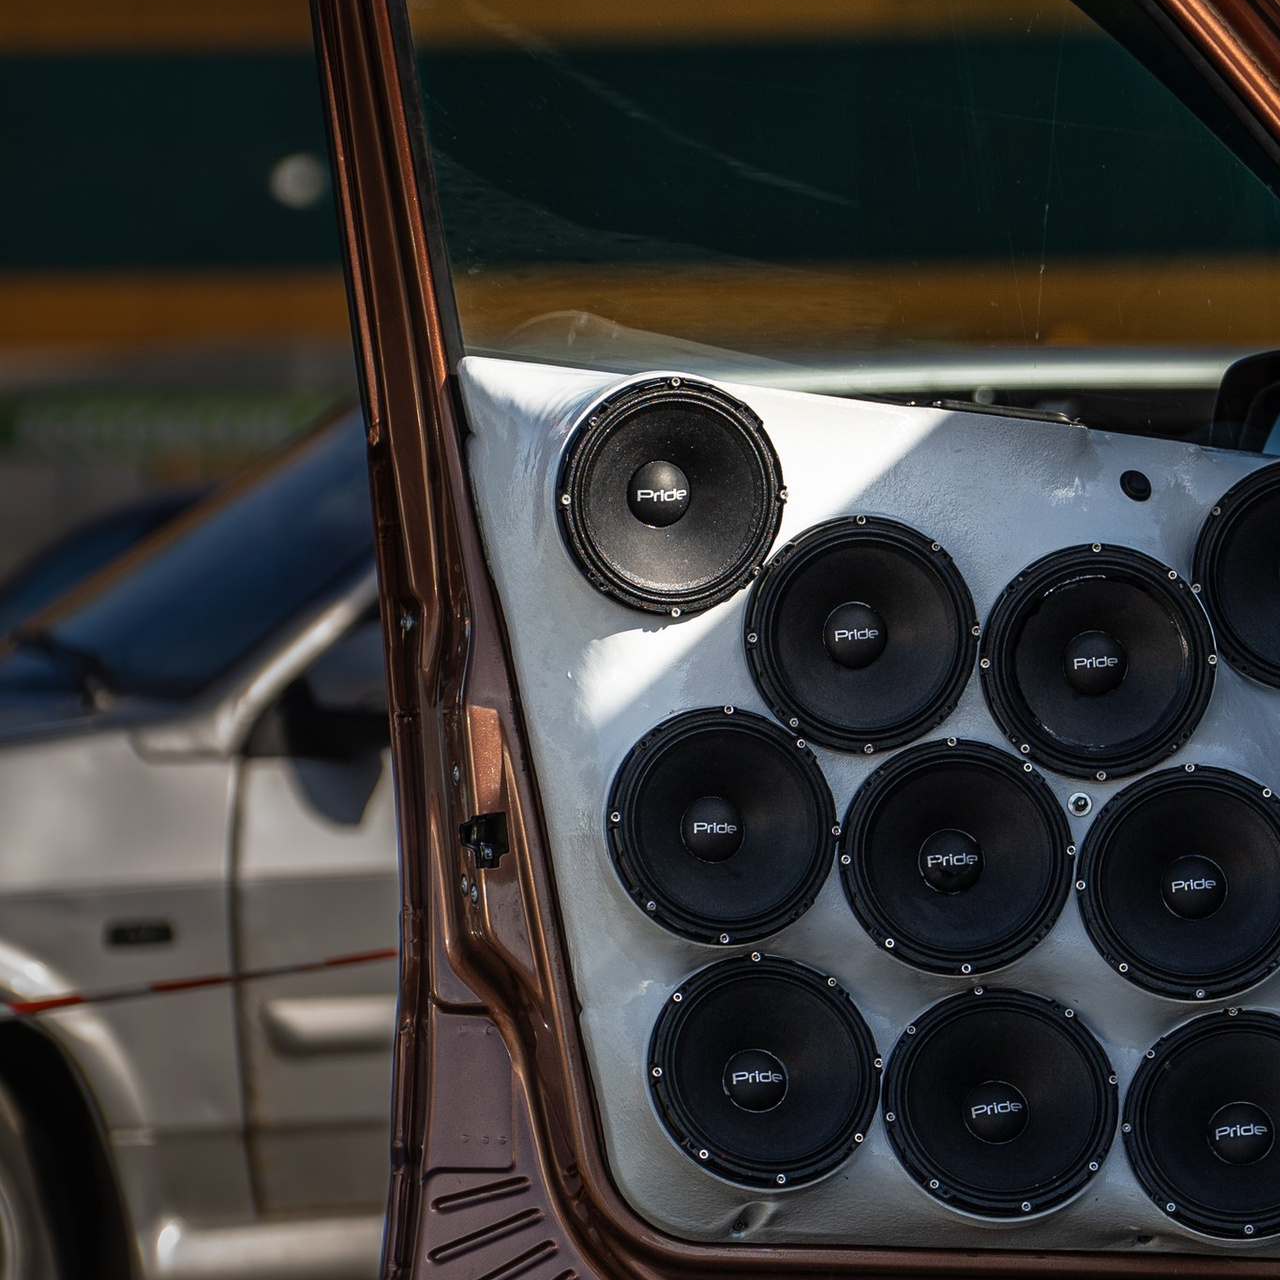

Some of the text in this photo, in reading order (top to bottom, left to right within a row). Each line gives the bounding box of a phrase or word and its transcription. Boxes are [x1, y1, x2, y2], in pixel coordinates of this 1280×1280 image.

[637, 488, 688, 502] Pride
[835, 628, 880, 641] Pride
[1074, 656, 1118, 669] Pride
[694, 822, 737, 834] Pride
[928, 853, 978, 867] Pride
[1172, 879, 1216, 892] Pride
[733, 1071, 783, 1085] Pride
[972, 1100, 1023, 1118] Pride
[1216, 1124, 1267, 1141] Pride
